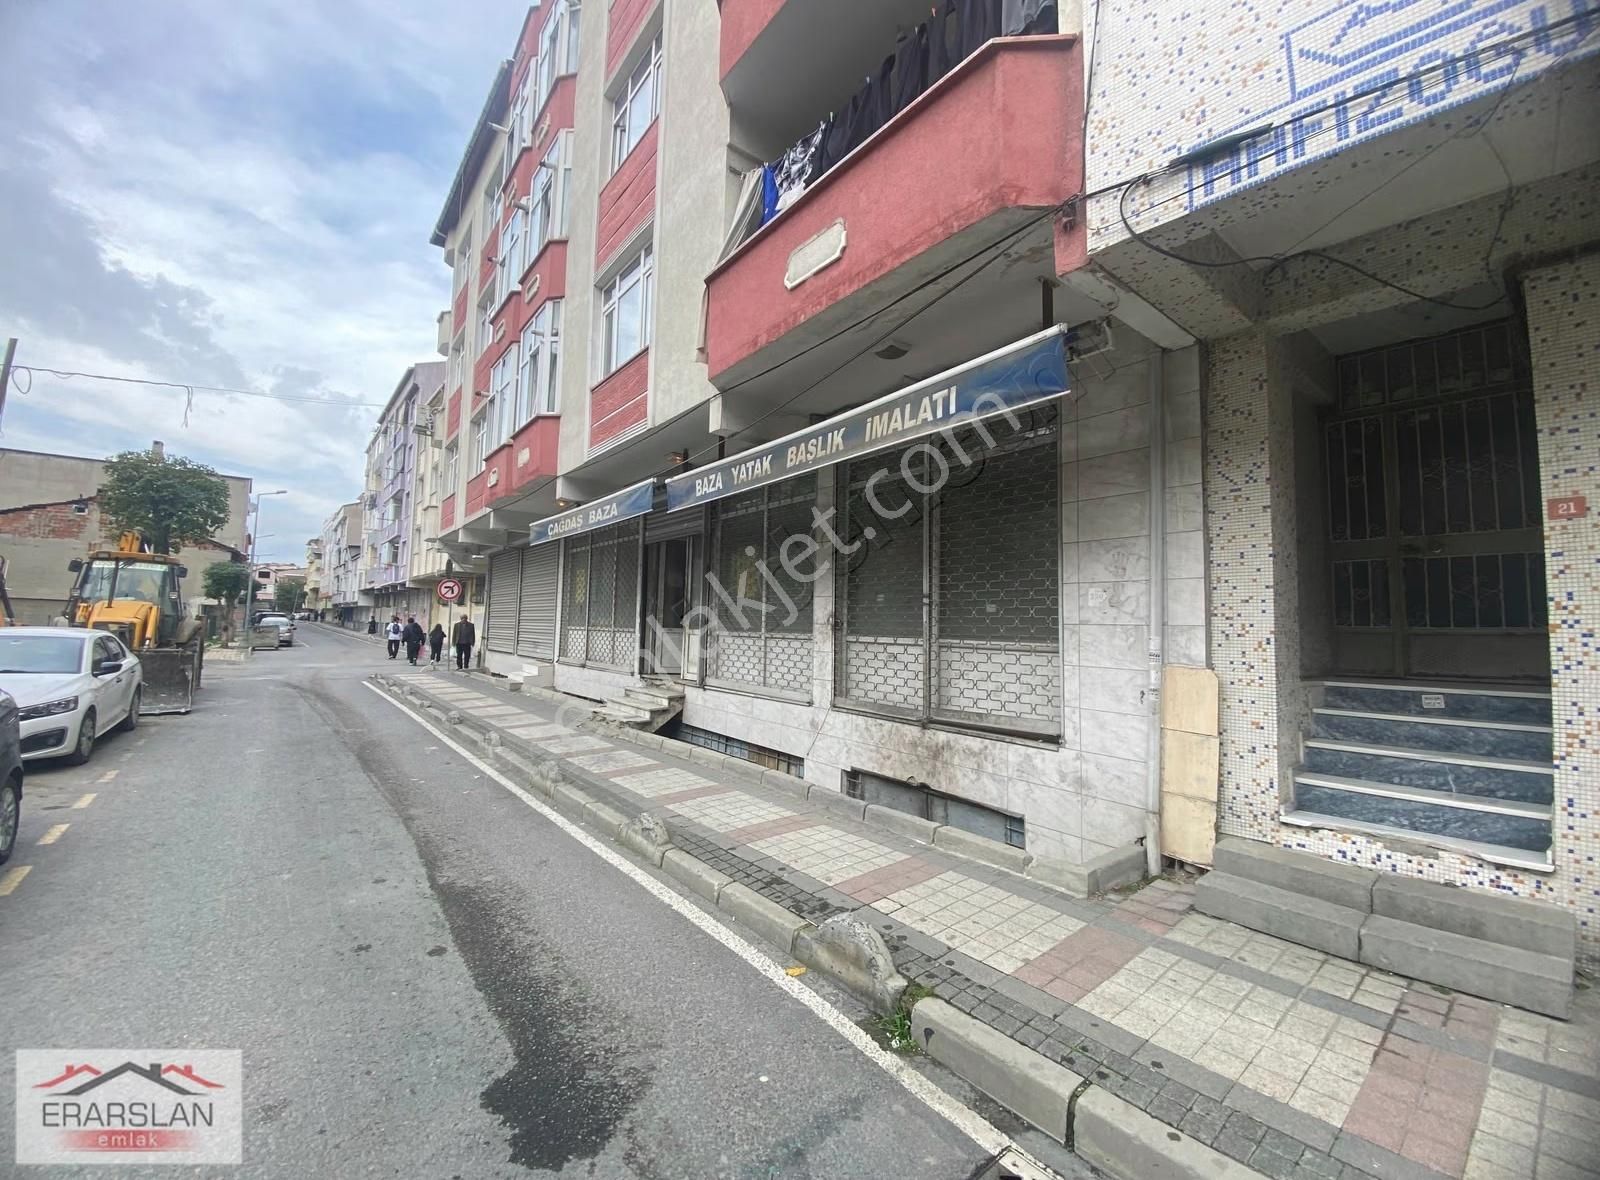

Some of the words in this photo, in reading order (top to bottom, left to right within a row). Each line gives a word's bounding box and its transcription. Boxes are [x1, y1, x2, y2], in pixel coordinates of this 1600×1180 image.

[695, 472, 723, 496] BAZA
[731, 454, 773, 486] YATAK
[787, 428, 845, 464] BAŞLIK
[865, 386, 957, 441] İMALATI
[588, 502, 618, 523] BAZA
[1558, 502, 1577, 514] 21
